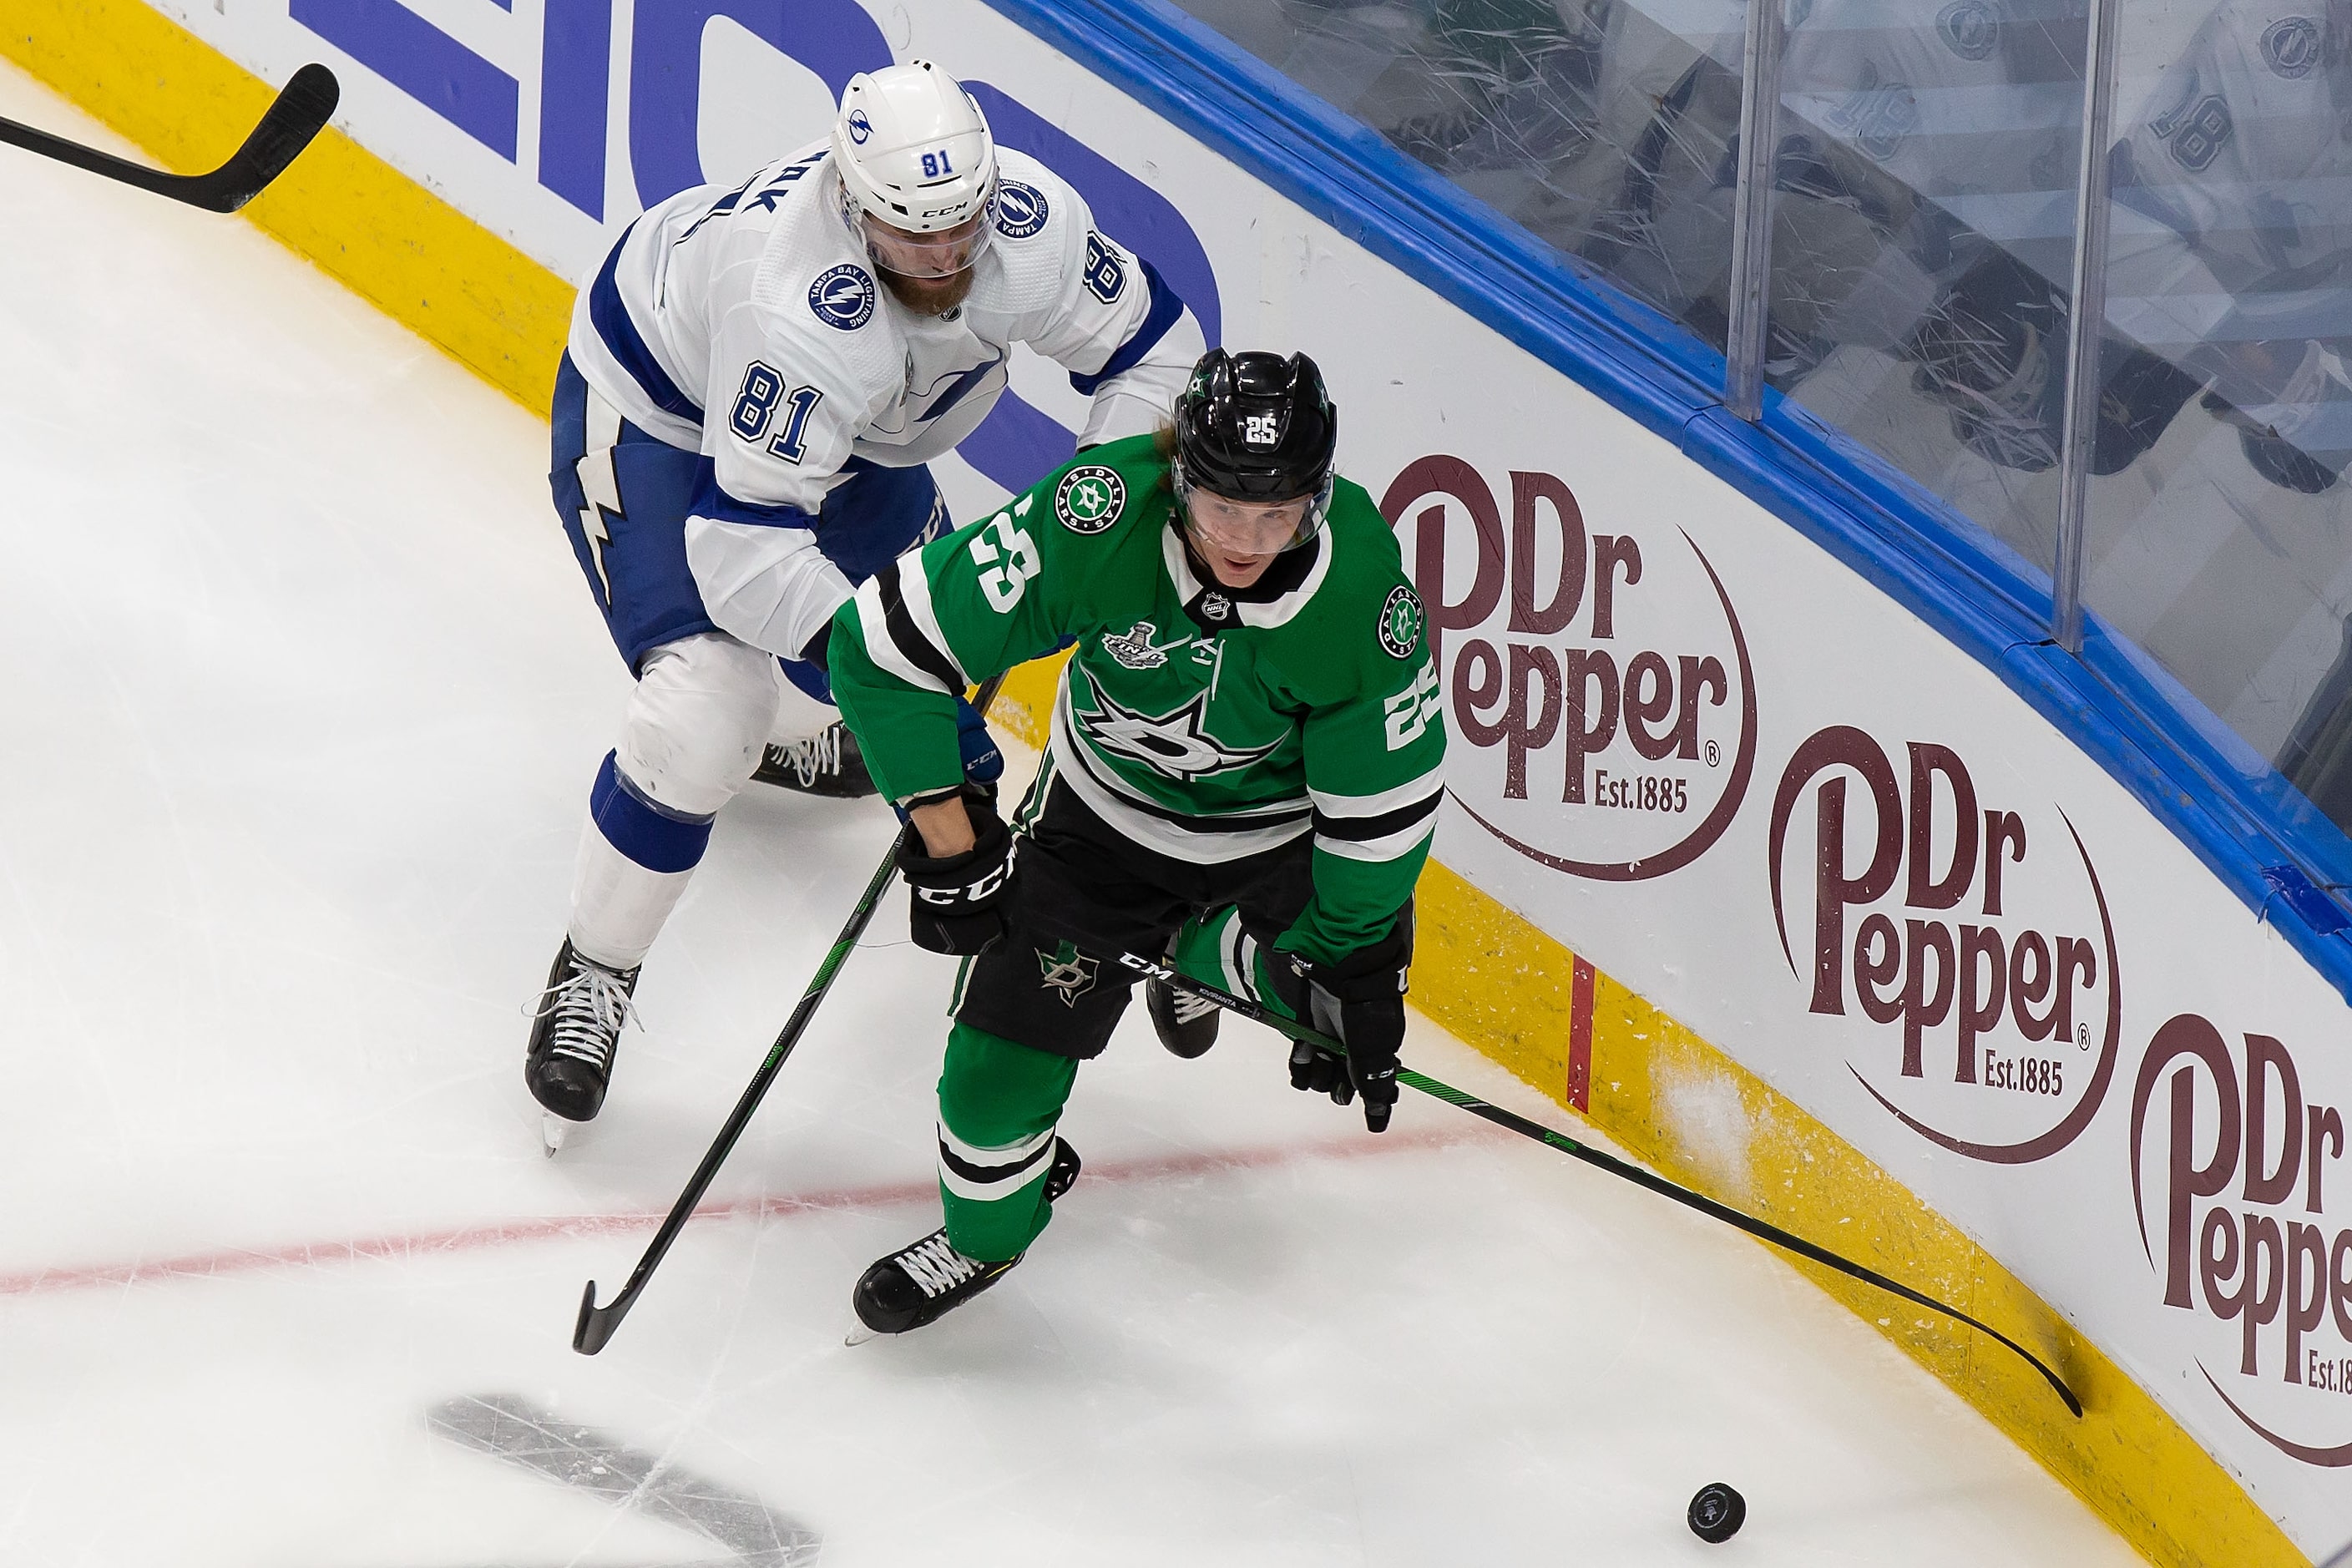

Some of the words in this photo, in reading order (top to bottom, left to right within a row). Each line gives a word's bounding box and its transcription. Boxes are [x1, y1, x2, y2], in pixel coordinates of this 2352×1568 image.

[921, 149, 953, 178] 81
[921, 201, 968, 218] CCM
[811, 271, 835, 299] TAMPA
[837, 266, 859, 276] BAY
[849, 275, 873, 327] LIGHTNING
[1082, 230, 1127, 305] 8
[728, 360, 823, 465] 81
[1247, 417, 1277, 444] 25
[1058, 473, 1080, 526] STARS
[1095, 469, 1120, 528] DALLAS
[1507, 470, 1642, 639] Dr
[1206, 604, 1223, 613] NHL
[1379, 454, 1728, 804] Pepper
[1383, 589, 1411, 643] DALLAS
[1904, 741, 2027, 917] Dr
[1768, 725, 2097, 1085] Pepper
[2242, 1032, 2344, 1213] Dr
[2131, 1013, 2352, 1385] Peppe
